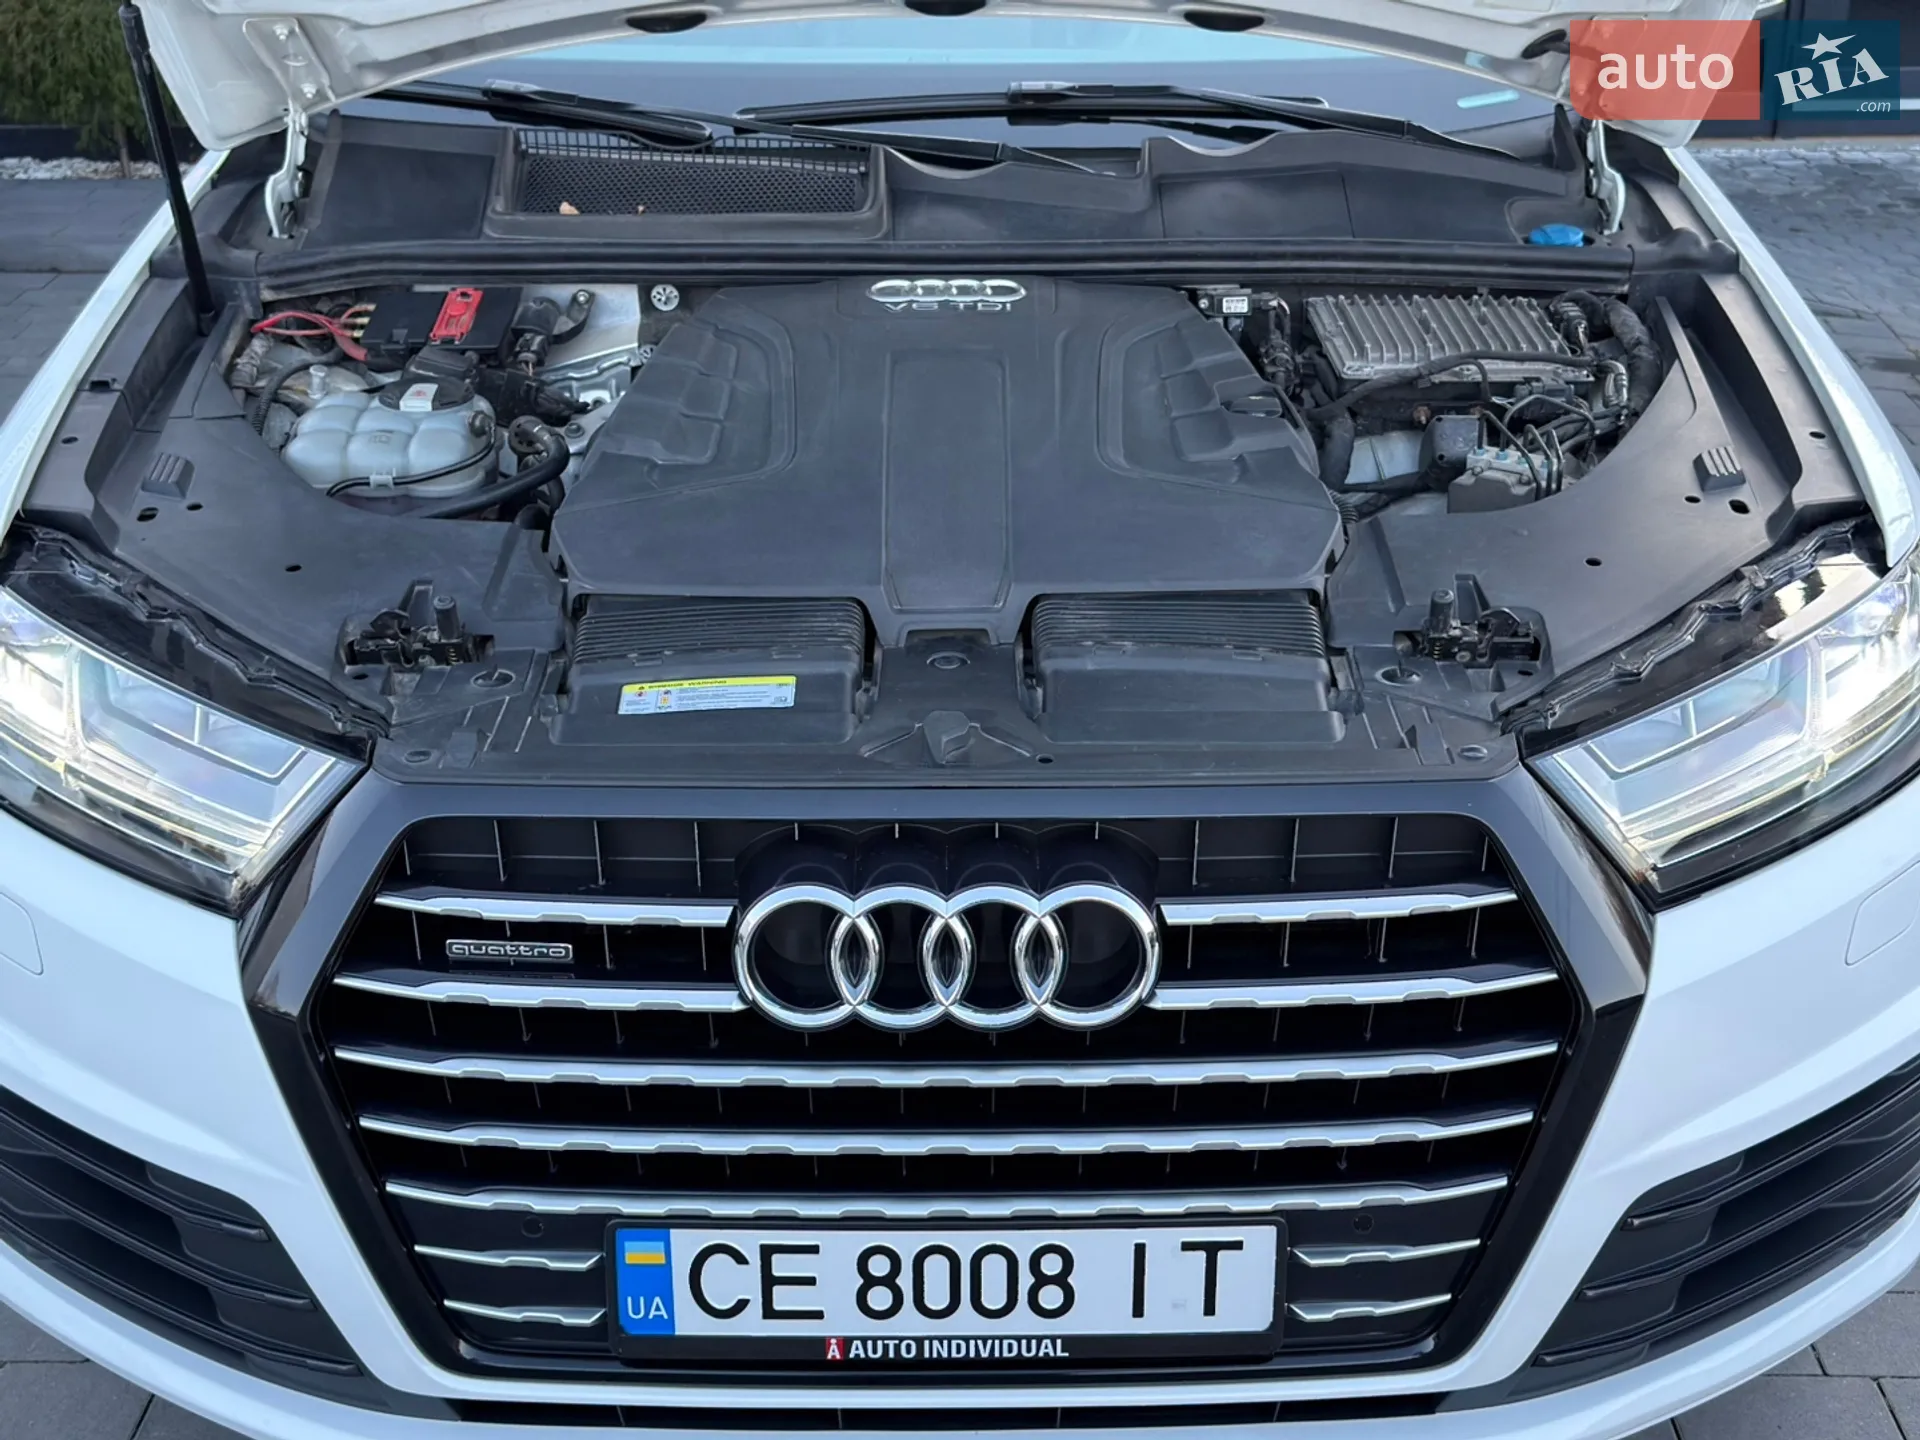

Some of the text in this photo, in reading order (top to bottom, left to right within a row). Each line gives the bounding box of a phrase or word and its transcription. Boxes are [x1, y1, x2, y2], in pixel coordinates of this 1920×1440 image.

[950, 301, 1012, 312] TDI
[451, 944, 566, 957] quattro
[688, 1242, 825, 1320] CE
[855, 1243, 1076, 1320] 8008
[627, 1296, 668, 1319] UA
[849, 1339, 917, 1359] AUTO
[923, 1338, 1069, 1359] INDIVIDUAL
